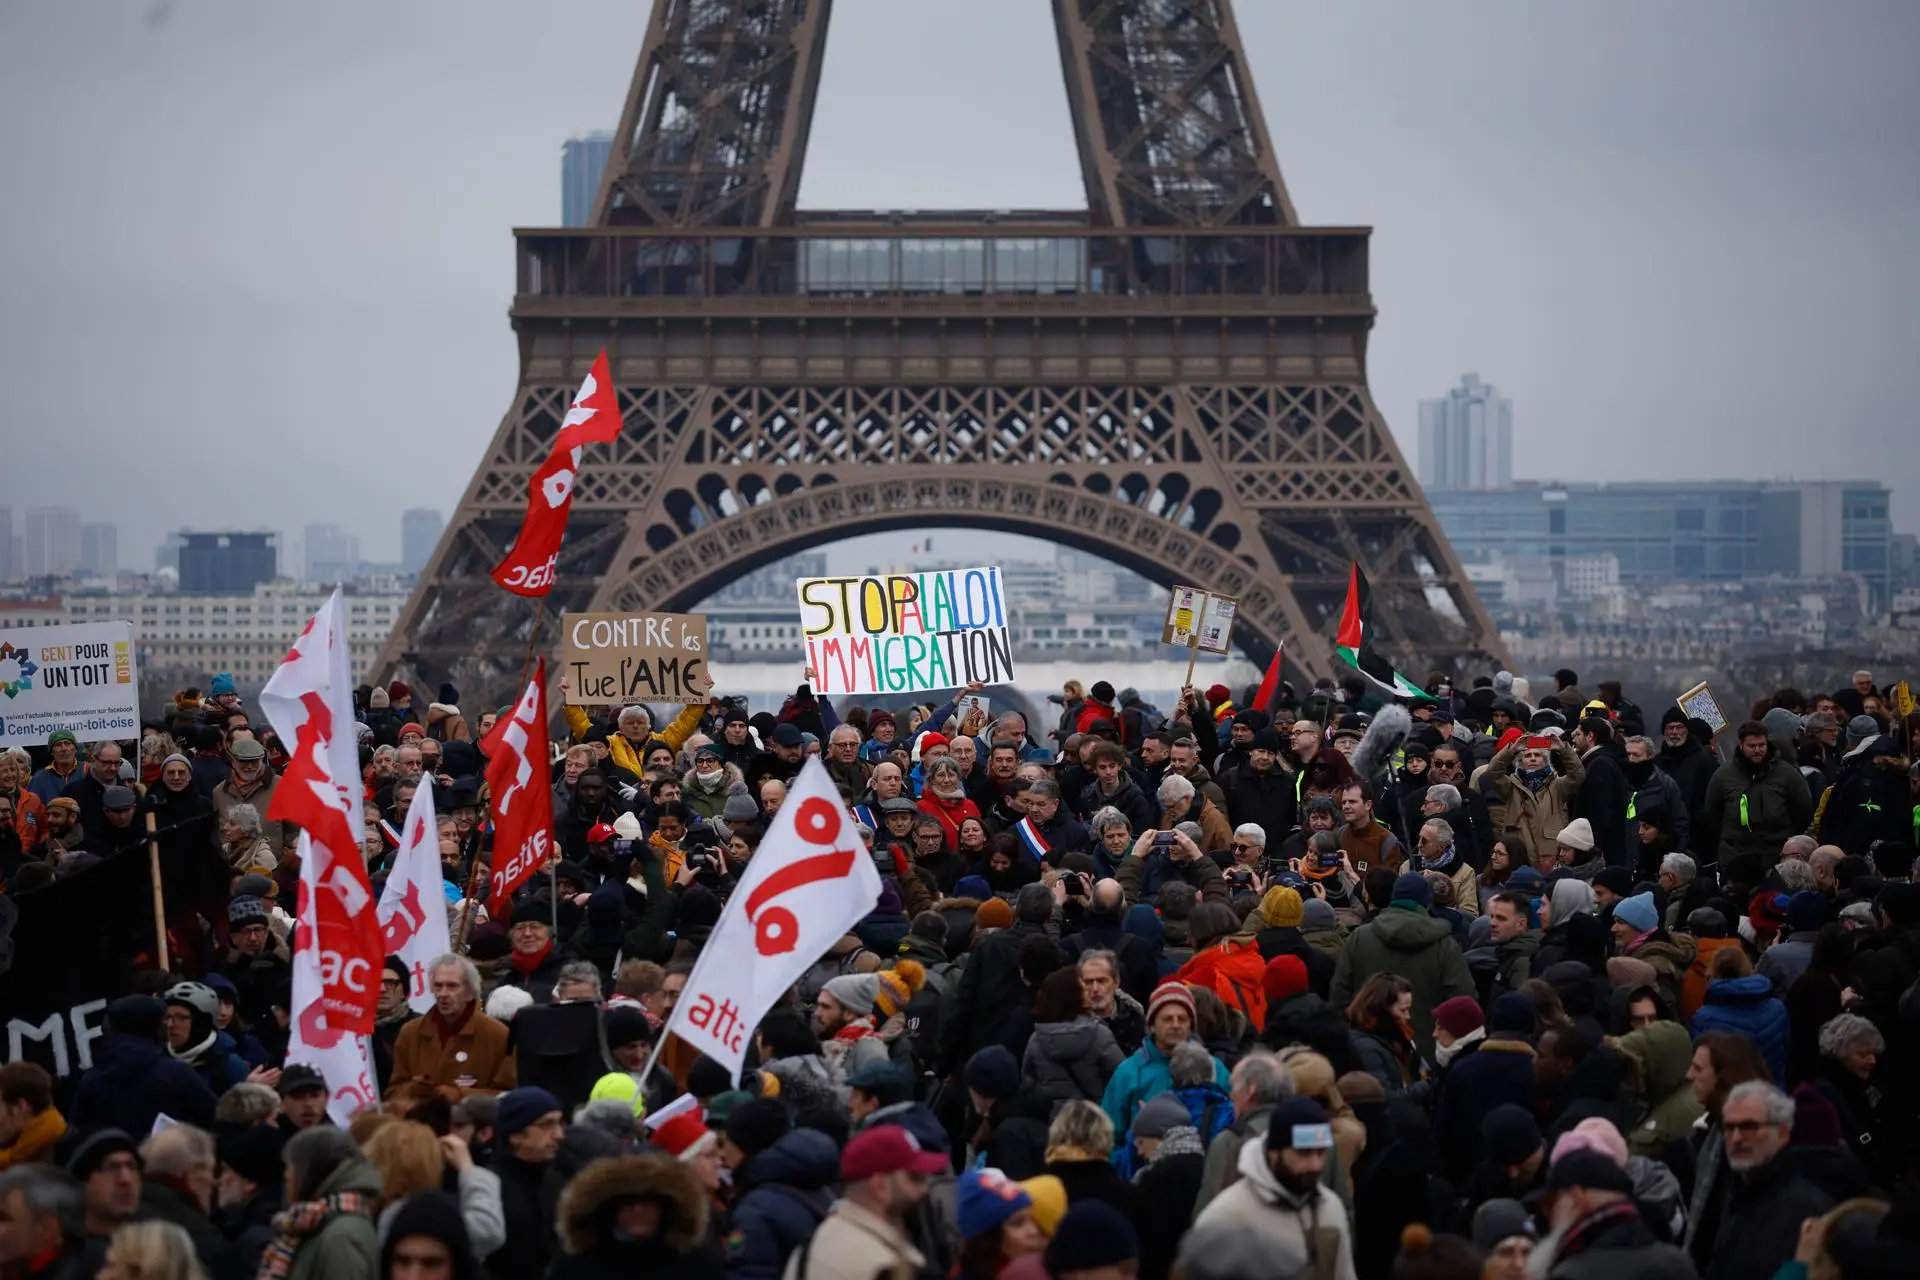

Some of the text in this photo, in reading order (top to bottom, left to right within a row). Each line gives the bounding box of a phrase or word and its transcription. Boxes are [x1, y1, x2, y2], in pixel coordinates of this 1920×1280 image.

[802, 576, 919, 635] STOP
[919, 572, 955, 632] LA
[572, 617, 701, 651] CONTRE les
[41, 643, 109, 662] CENT POUR
[116, 647, 130, 677] OISE
[43, 663, 110, 688] UN TOIT
[570, 661, 616, 698] Tue
[107, 705, 134, 713] facebook
[7, 717, 135, 737] Cent-pour-un-toit-oise
[688, 993, 746, 1055] attc
